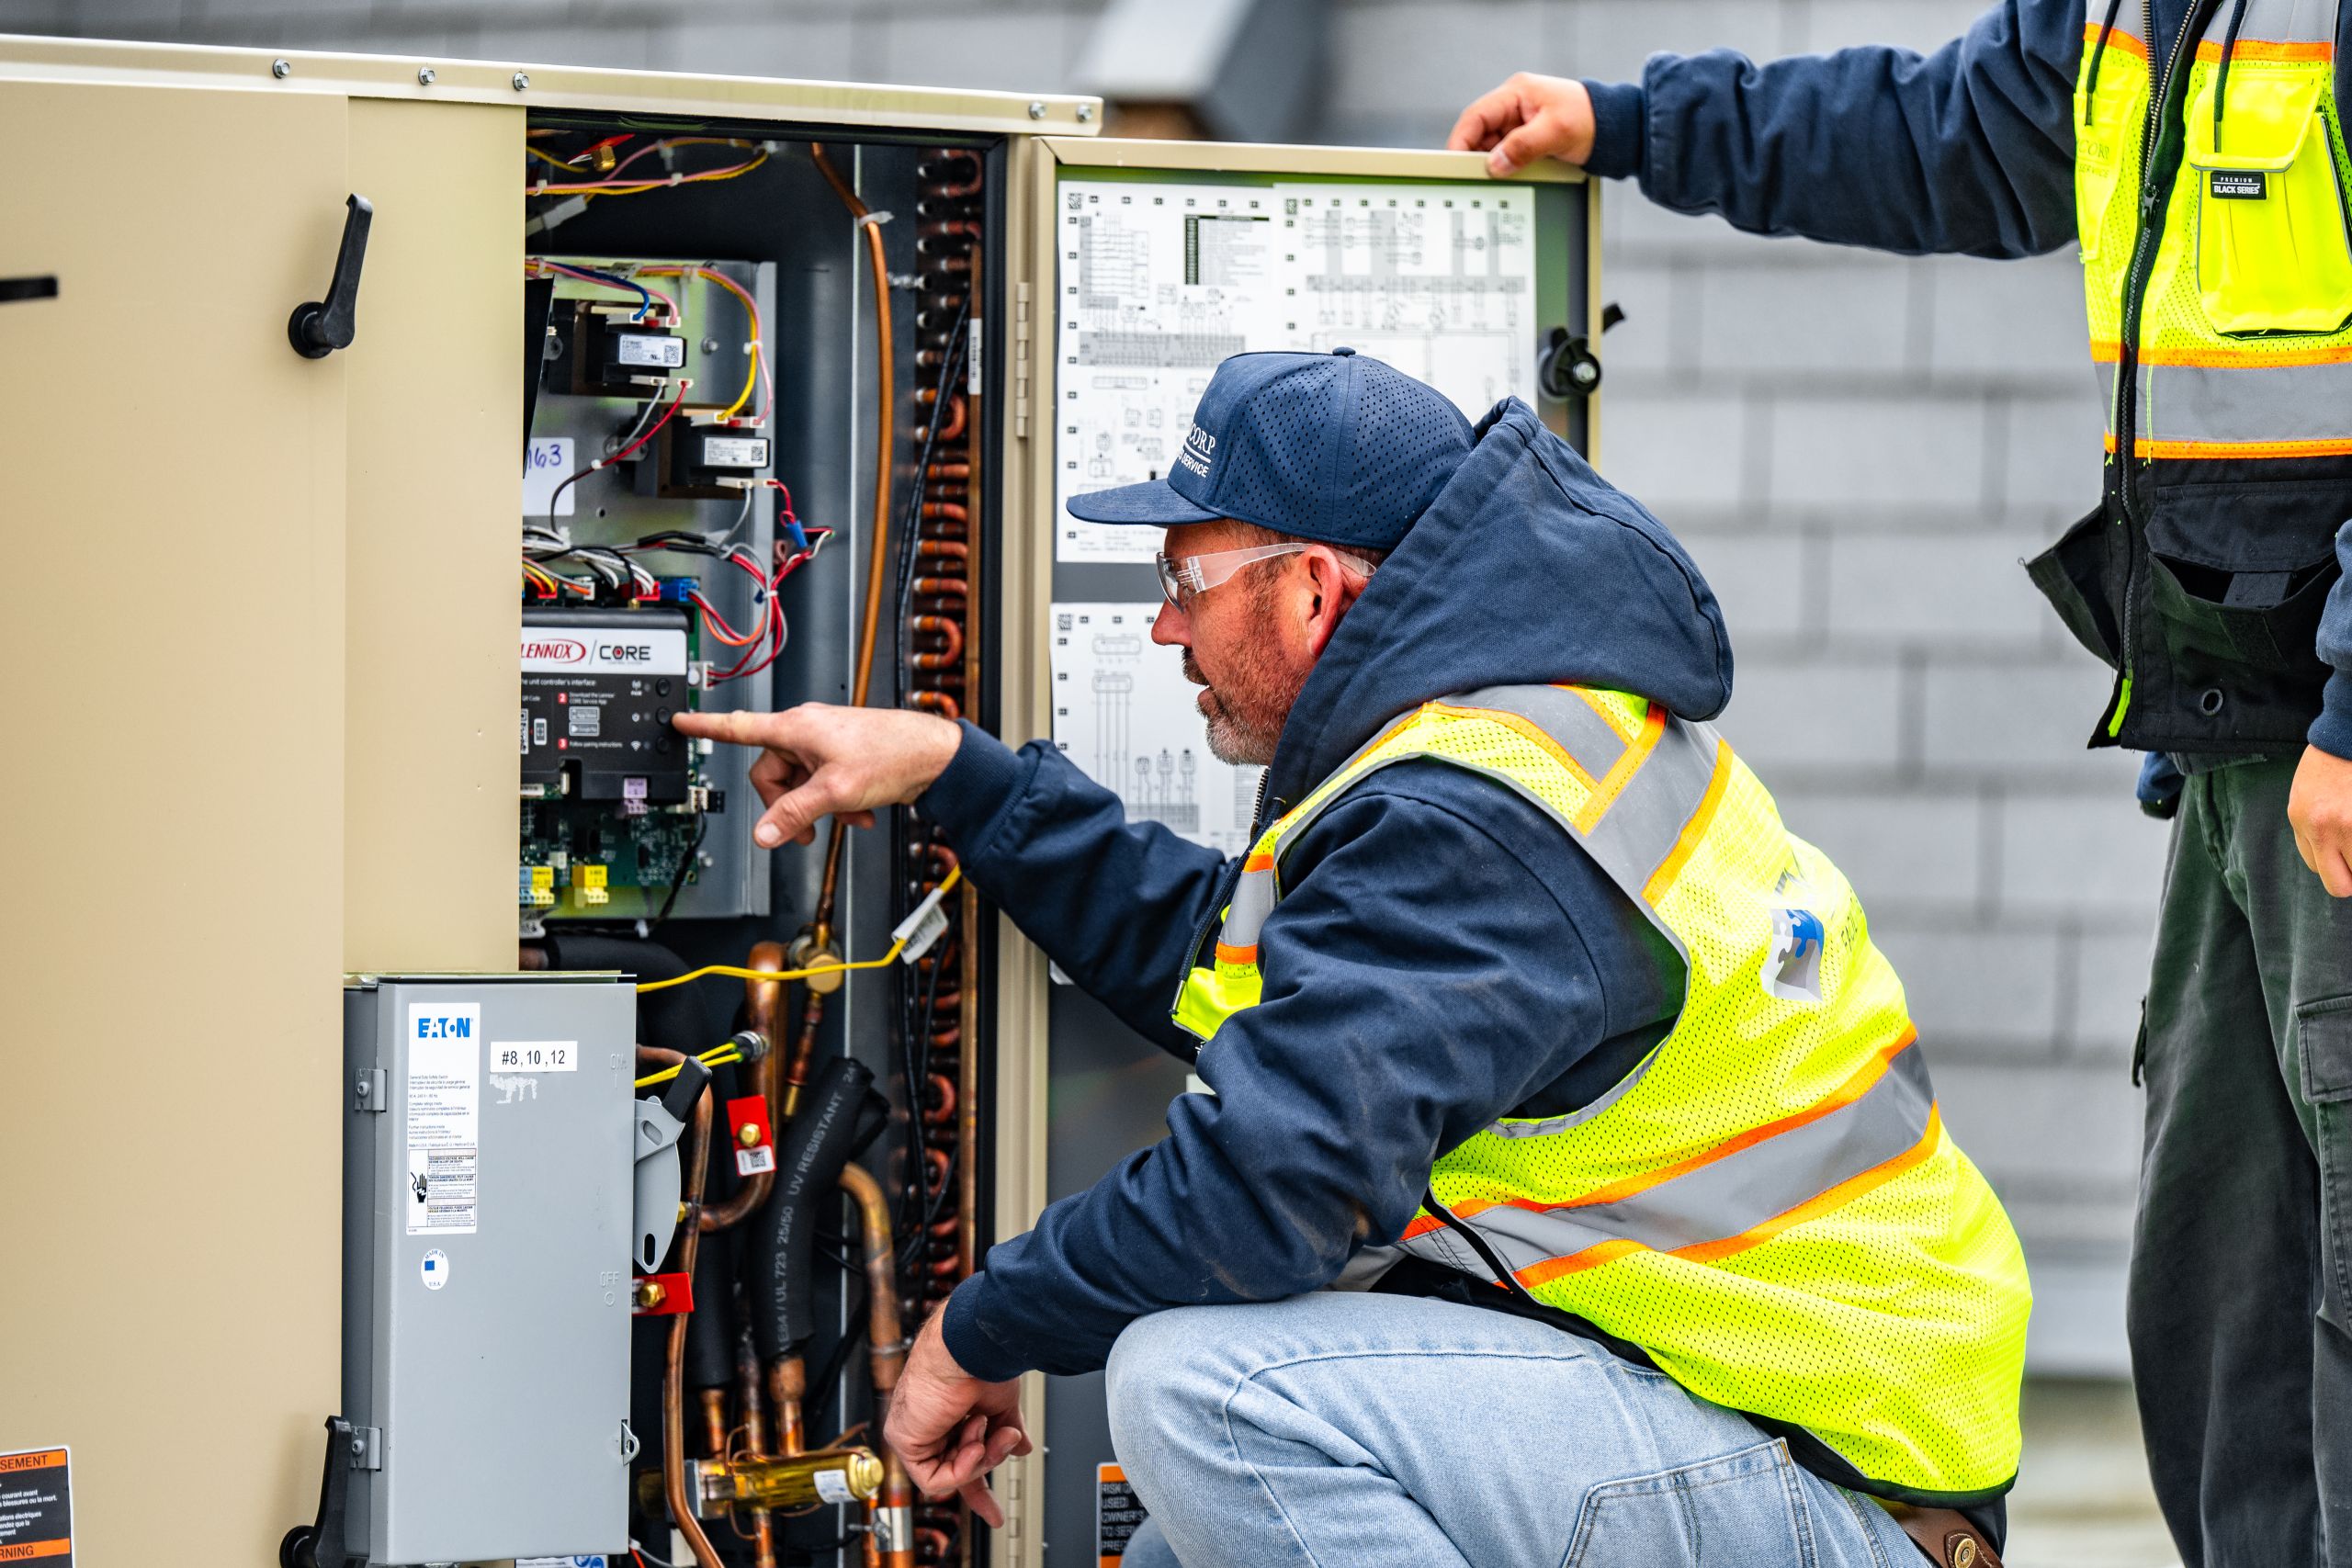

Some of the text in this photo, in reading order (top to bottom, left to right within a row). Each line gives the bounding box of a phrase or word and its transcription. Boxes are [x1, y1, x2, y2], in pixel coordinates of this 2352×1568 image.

[2213, 185, 2236, 194] BLACK
[1189, 423, 1216, 455] CORP
[1182, 452, 1209, 478] SERVICE
[521, 643, 651, 660] LENNOX CORE
[571, 679, 596, 687] interface
[560, 693, 566, 703] 2
[560, 739, 567, 749] 3
[418, 1018, 470, 1038] EATON
[797, 1091, 843, 1173] RESISTANT
[788, 1174, 804, 1195] UV
[775, 1251, 787, 1279] 723
[775, 1280, 786, 1303] UL
[2, 1489, 38, 1500] courant avant
[3, 1498, 28, 1507] blessures
[42, 1495, 57, 1503] mort.
[15, 1511, 41, 1520] électriques
